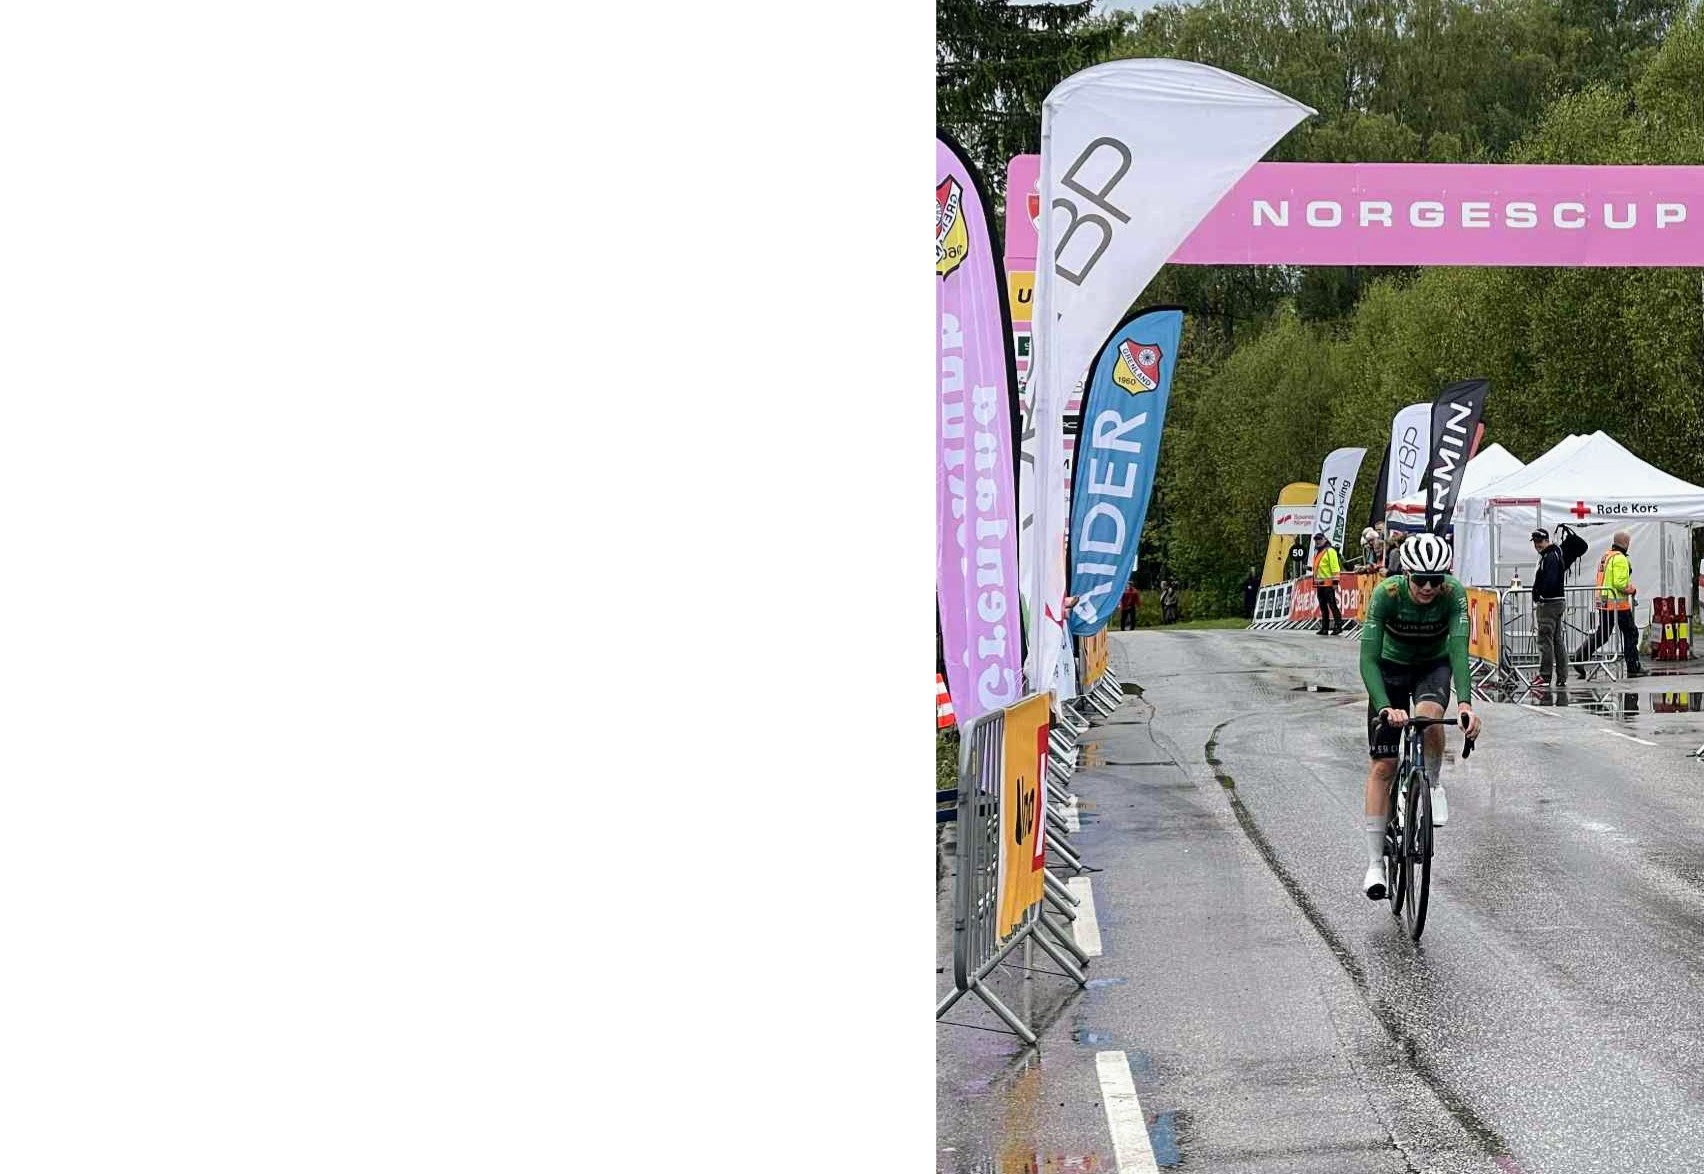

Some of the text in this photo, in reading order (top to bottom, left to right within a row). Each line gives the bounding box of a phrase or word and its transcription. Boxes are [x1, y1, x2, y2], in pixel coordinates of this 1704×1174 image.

[1053, 137, 1131, 286] BP
[1252, 200, 1687, 229] NORGESCUP
[1597, 503, 1658, 515] Røde Kors
[1292, 548, 1304, 557] 50
[1015, 776, 1035, 846] Uno
